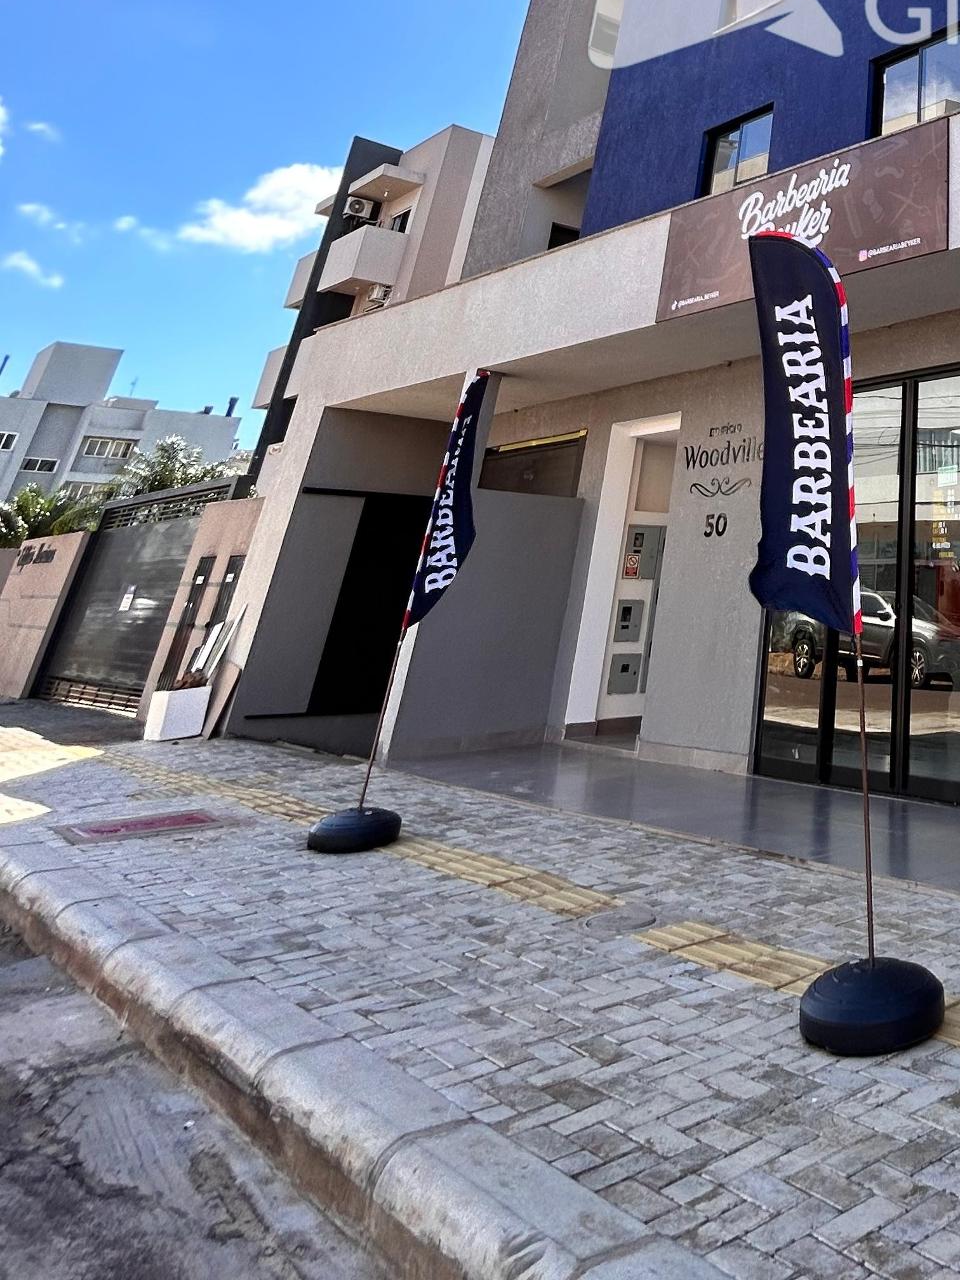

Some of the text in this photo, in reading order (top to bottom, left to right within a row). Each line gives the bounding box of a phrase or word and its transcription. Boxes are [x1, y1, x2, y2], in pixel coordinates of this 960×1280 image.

[739, 158, 851, 234] Barbearia
[741, 200, 832, 248] ker
[774, 294, 832, 580] BARBEARIA
[424, 414, 473, 594] BARBEA
[703, 513, 728, 537] 50
